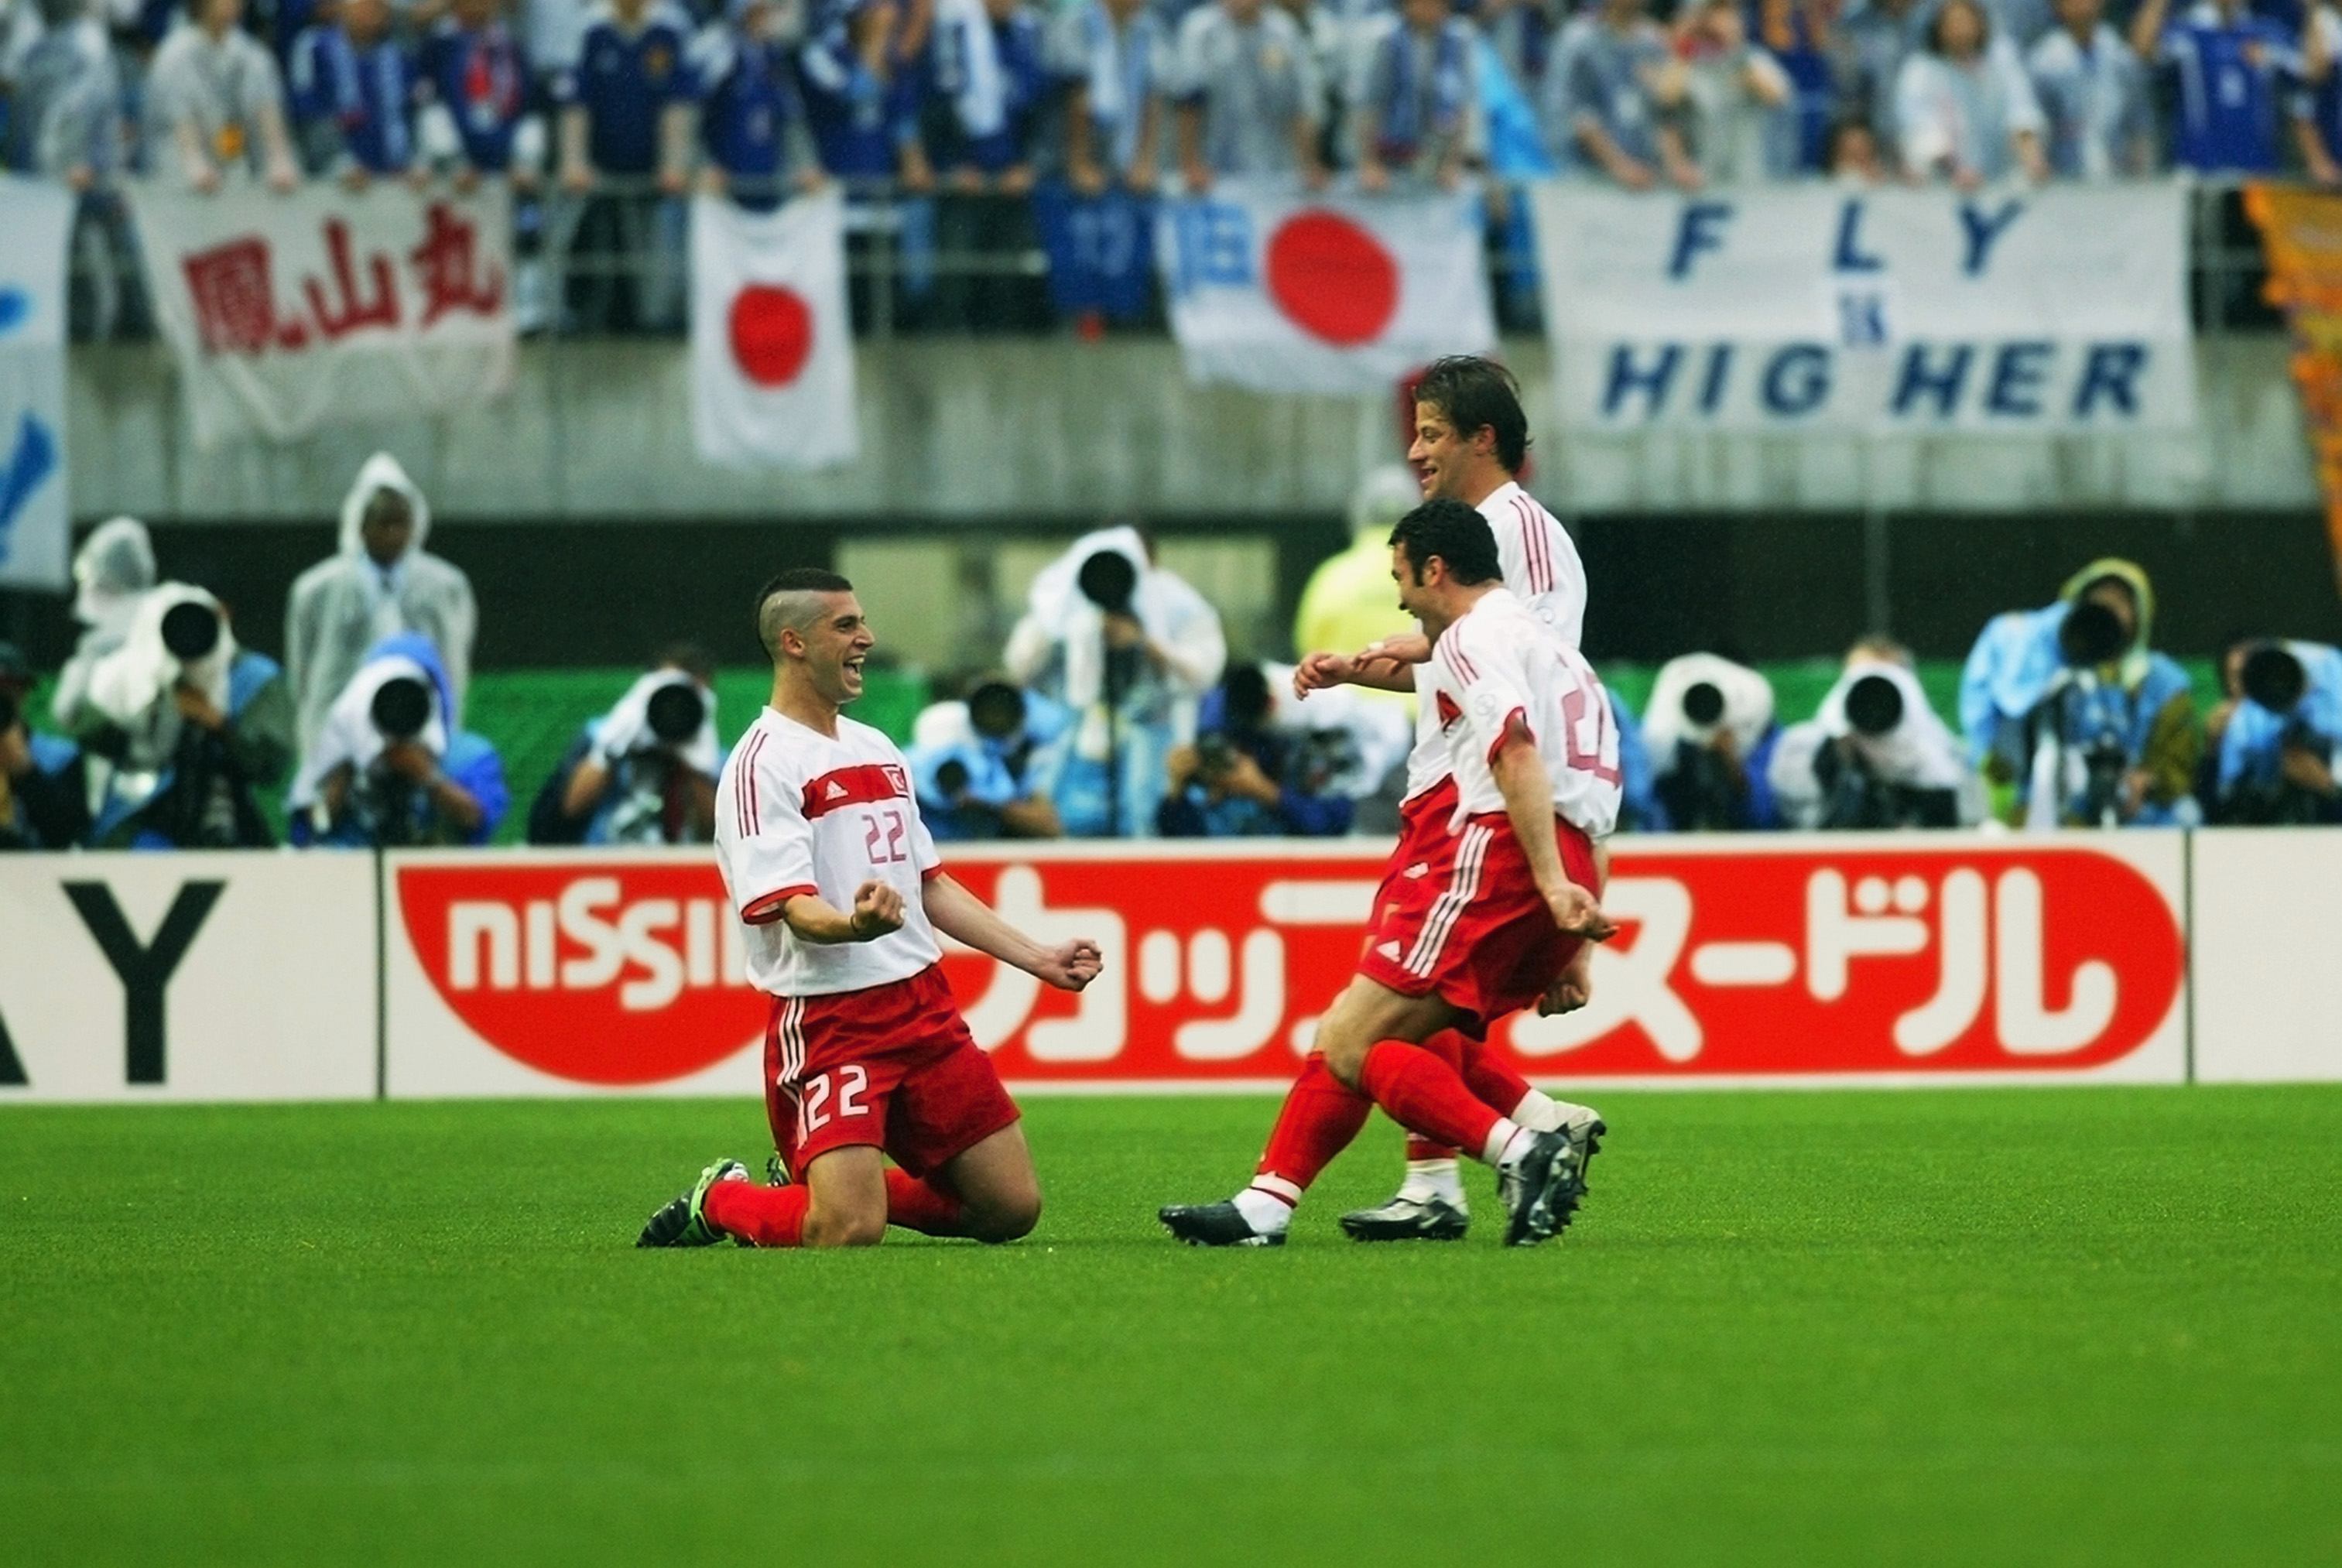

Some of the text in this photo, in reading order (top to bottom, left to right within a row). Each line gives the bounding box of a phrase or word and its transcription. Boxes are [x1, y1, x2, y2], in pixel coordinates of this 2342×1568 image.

[1666, 198, 2026, 279] FLY
[1601, 342, 2149, 418] HIGHER
[861, 810, 907, 864] 22
[0, 879, 229, 1086] Y
[805, 1065, 869, 1132] 22
